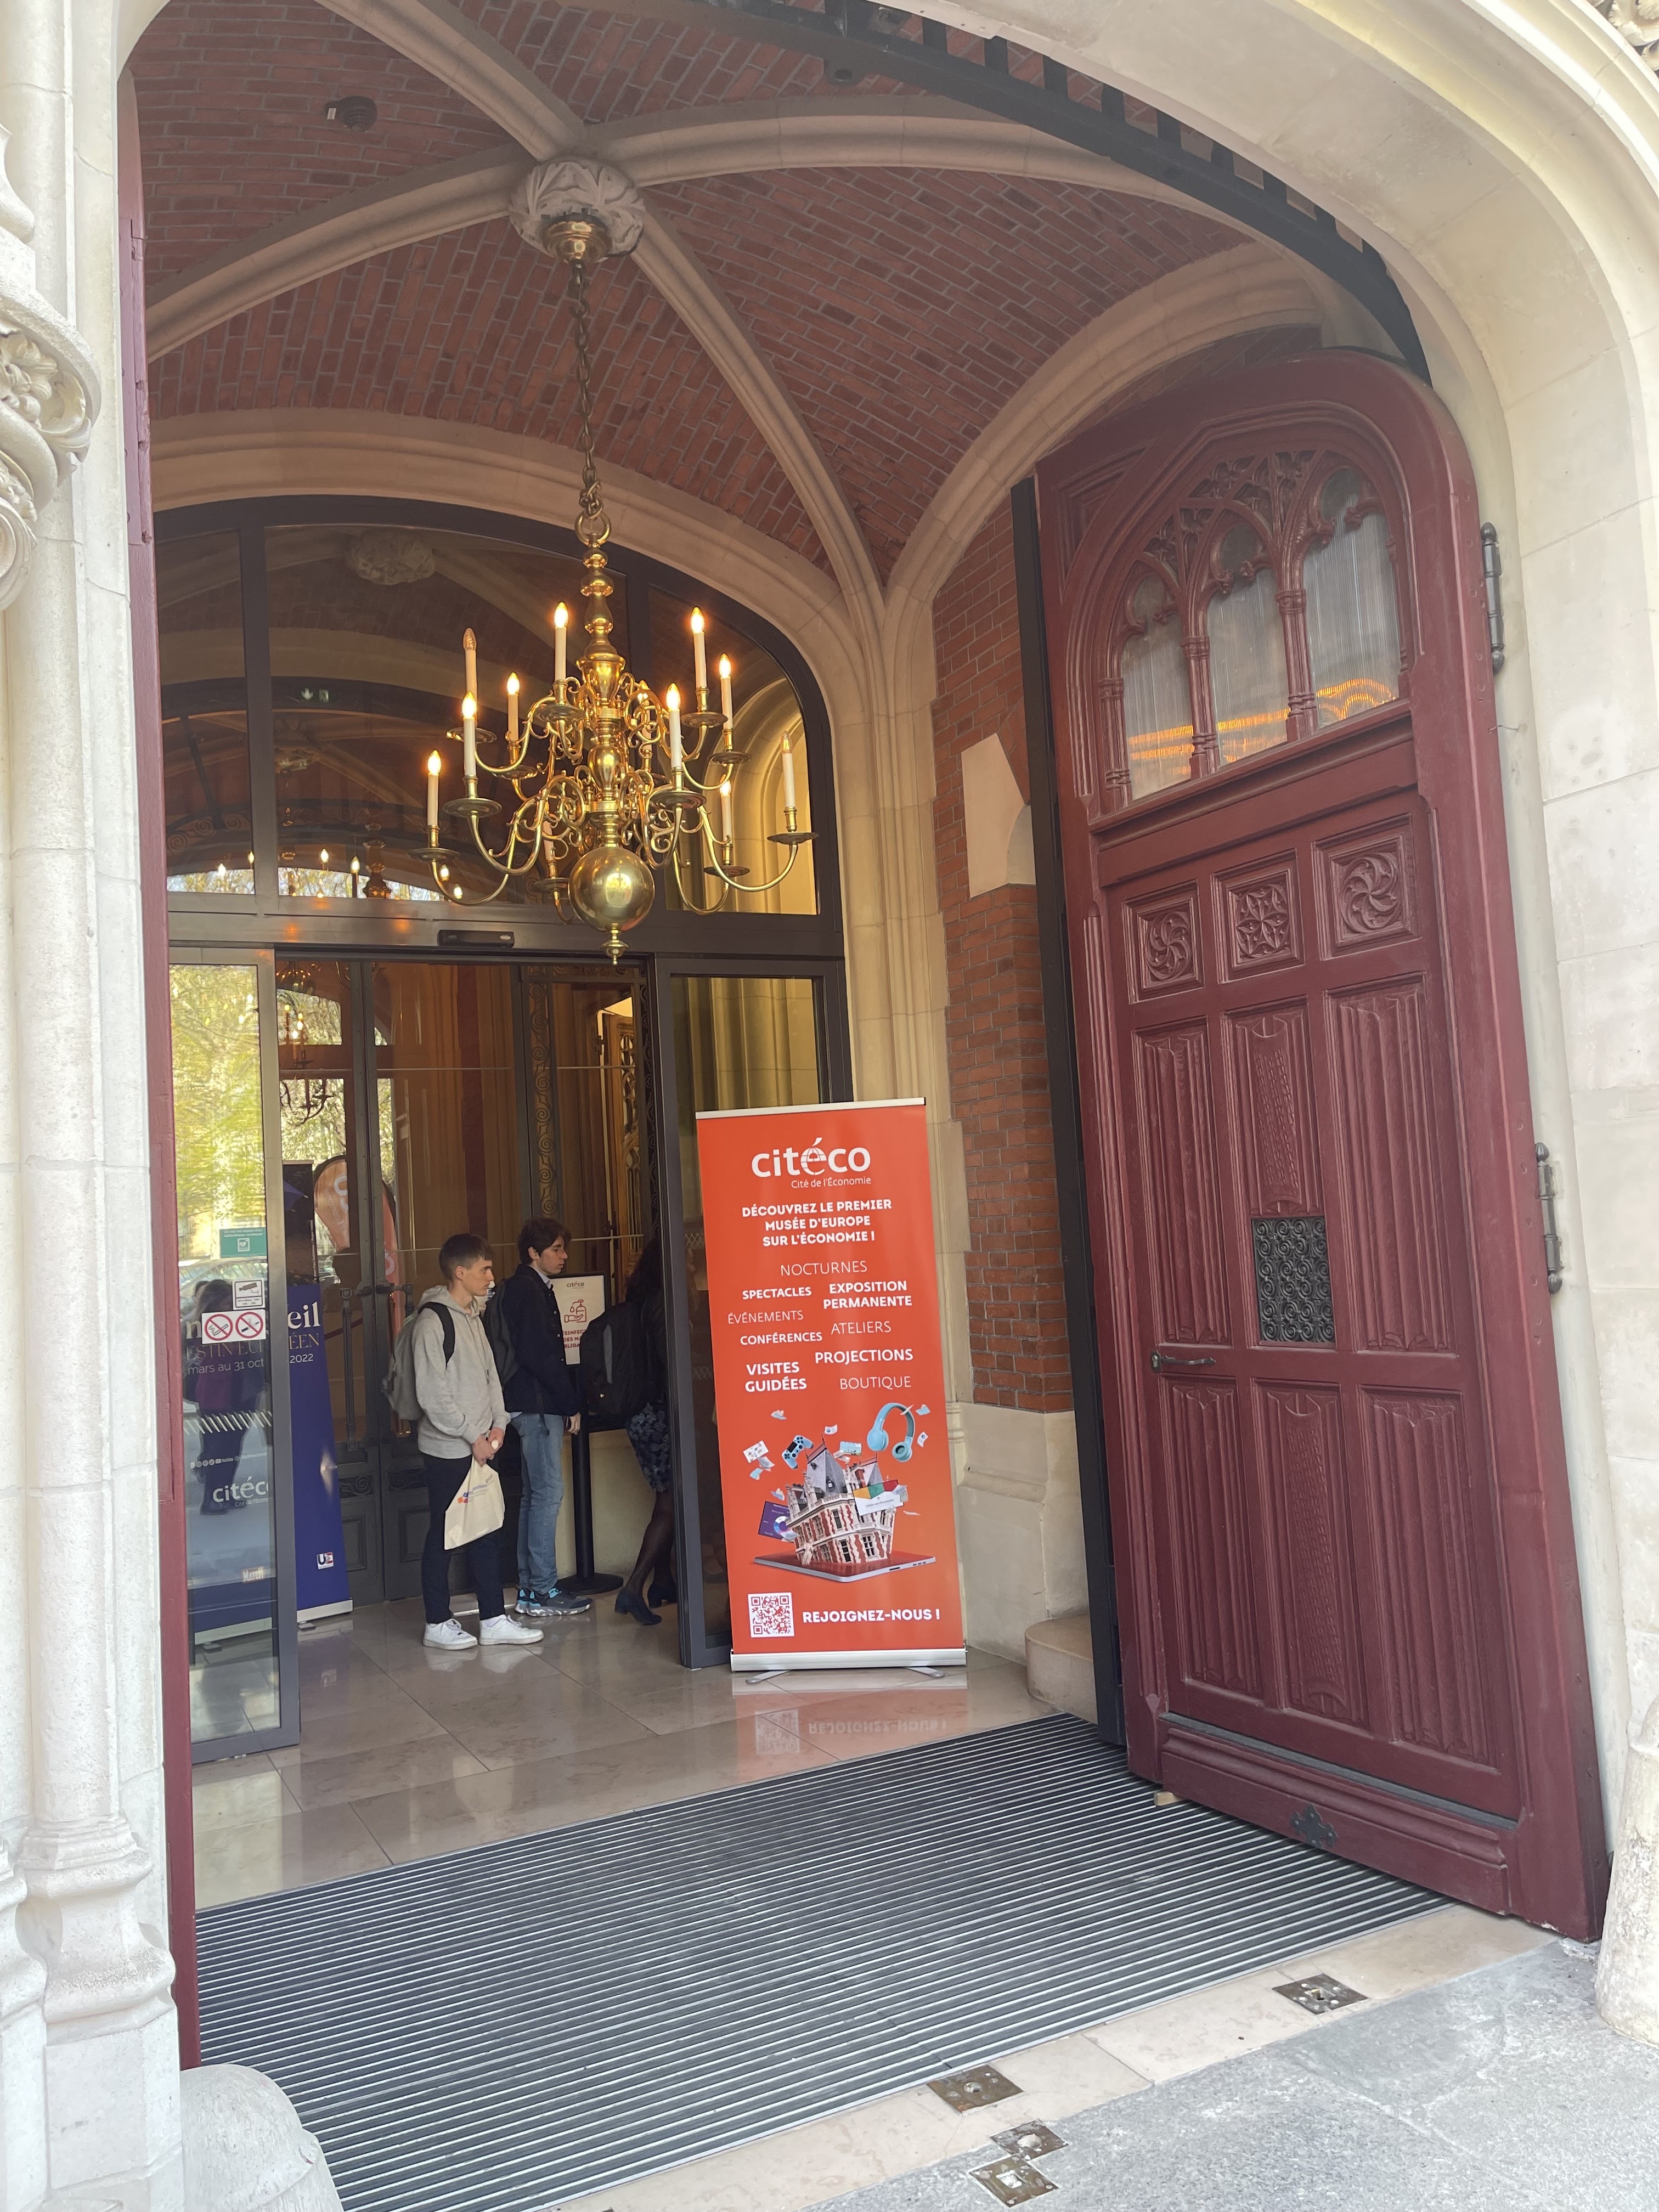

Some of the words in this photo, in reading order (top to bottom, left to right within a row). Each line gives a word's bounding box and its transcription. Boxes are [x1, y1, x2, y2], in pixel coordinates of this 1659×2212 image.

[752, 1137, 870, 1177] citéco
[792, 1180, 809, 1188] Cité
[811, 1179, 821, 1187] de
[823, 1176, 871, 1186] l'Économie
[742, 1203, 817, 1217] DÉCOUVREZ
[820, 1202, 833, 1212] LE
[837, 1199, 891, 1211] PREMIER
[765, 1217, 806, 1231] MUSÉE
[809, 1216, 870, 1228] D'EUROPE
[763, 1236, 788, 1246] SUR
[792, 1231, 868, 1244] L'ÉCONOMIE
[871, 1231, 874, 1240] !
[781, 1261, 867, 1276] NOCTURNES
[743, 1287, 811, 1299] SPECTACLES
[830, 1280, 907, 1294] EXPOSITION
[823, 1296, 912, 1309] PERMANENTE
[287, 1301, 320, 1329] eil
[728, 1310, 803, 1324] ÉVÉNEMENTS
[831, 1321, 891, 1334] ATELIERS
[741, 1332, 822, 1345] CONFÉRENCES
[815, 1349, 913, 1364] PROJECTIONS
[188, 1364, 215, 1375] mars
[234, 1361, 245, 1372] 31
[247, 1358, 265, 1368] oct
[290, 1353, 313, 1363] 2022
[746, 1362, 799, 1375] VISITES
[746, 1376, 806, 1392] GUIDÉES
[840, 1376, 911, 1390] BOUTIQUE
[212, 1476, 269, 1503] citéc
[803, 1609, 932, 1623] REJOIGNEZ-NOUS
